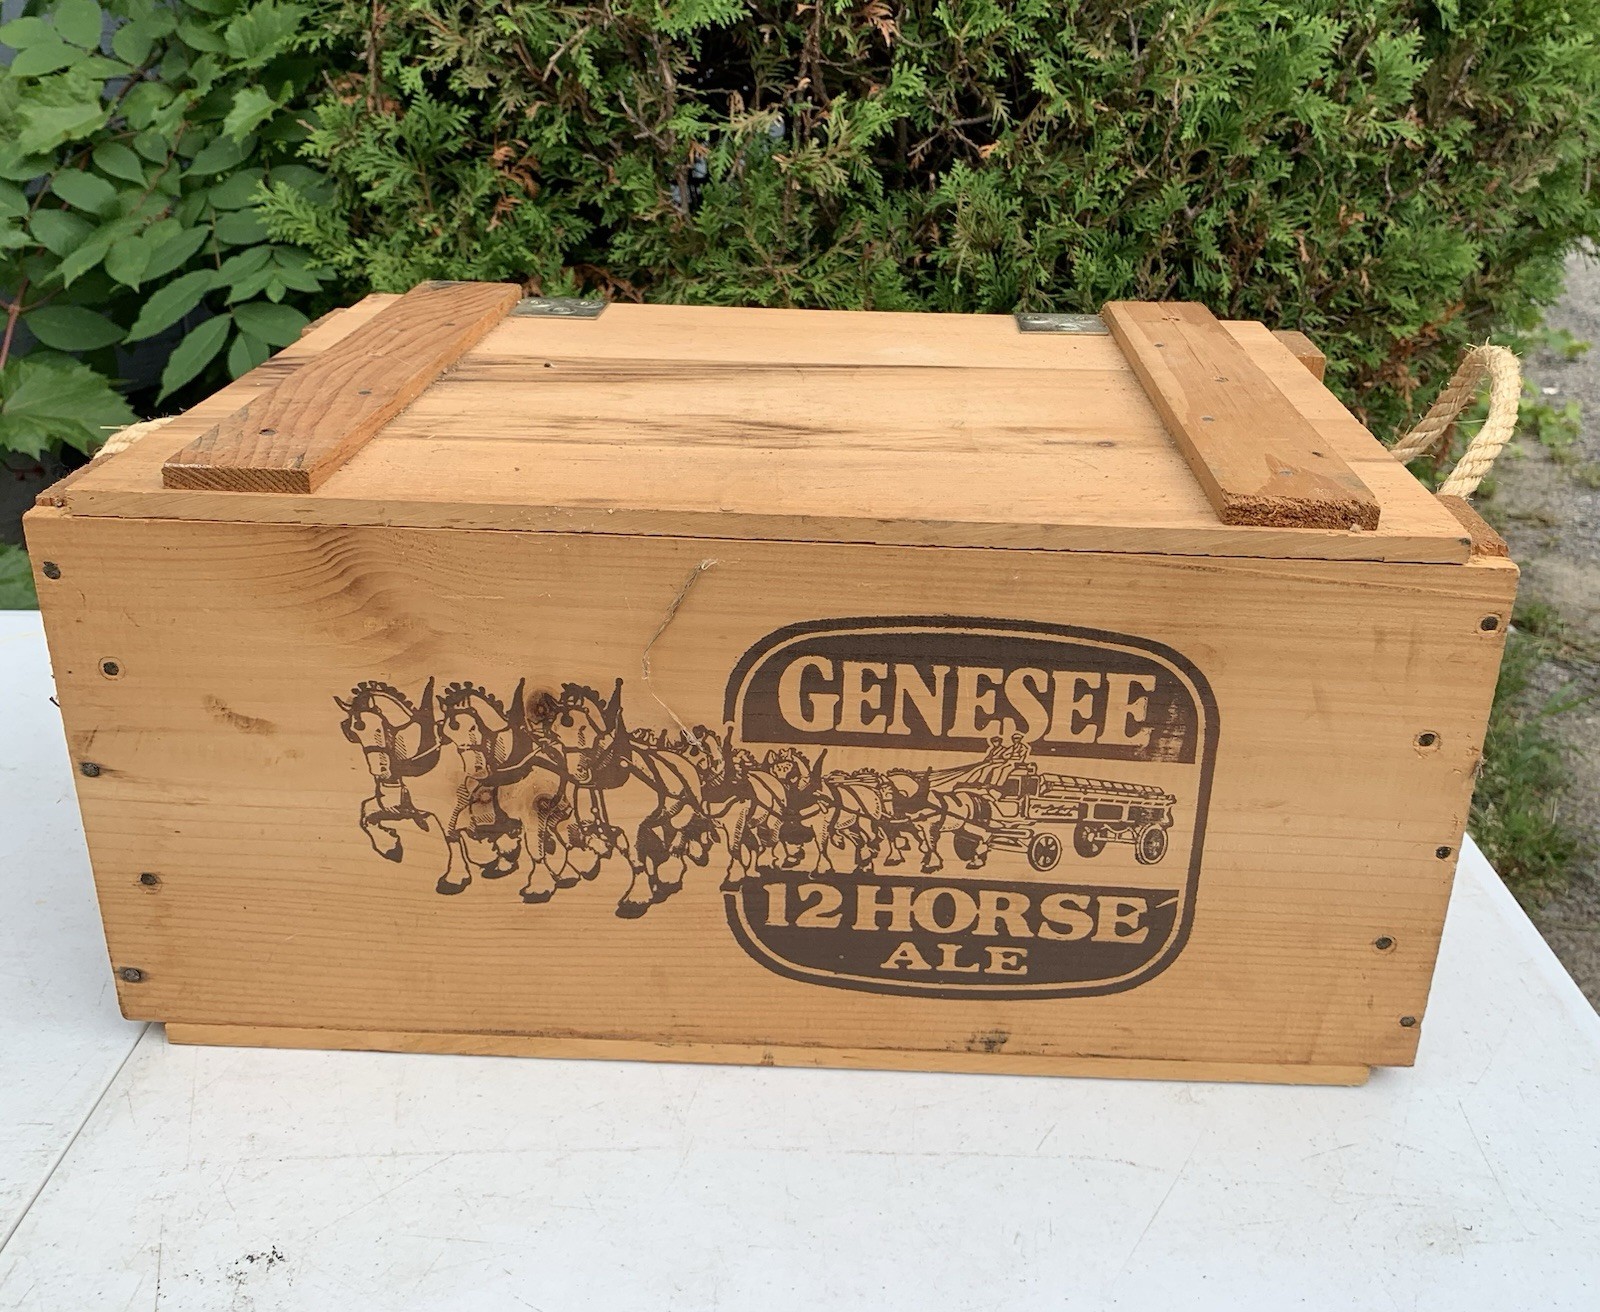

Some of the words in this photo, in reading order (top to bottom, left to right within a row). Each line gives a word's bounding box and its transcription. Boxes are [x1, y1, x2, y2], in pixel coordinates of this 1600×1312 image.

[778, 655, 1157, 748] GENESEE
[763, 883, 844, 930] 12
[852, 884, 1152, 944] HORSE
[880, 942, 1029, 975] ALE
